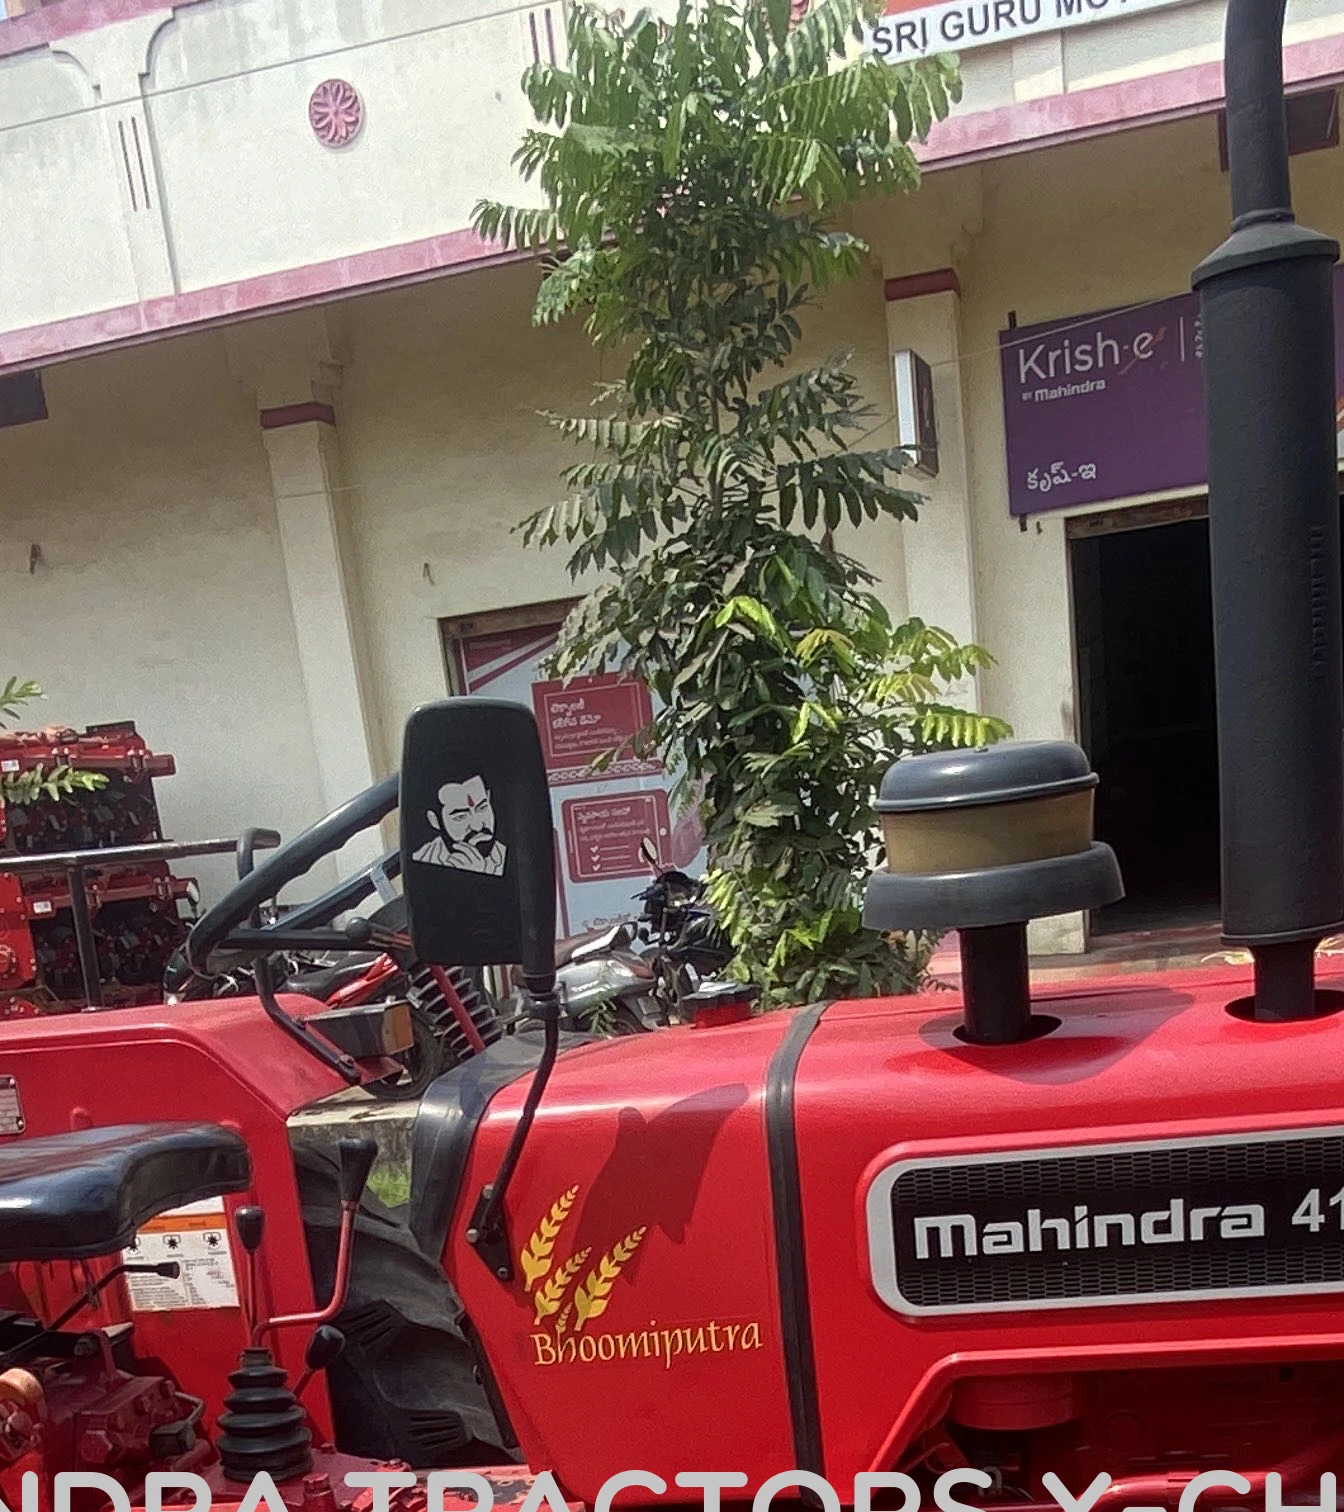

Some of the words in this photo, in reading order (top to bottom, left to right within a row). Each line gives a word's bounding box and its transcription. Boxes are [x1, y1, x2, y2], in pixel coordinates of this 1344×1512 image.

[871, 18, 929, 57] SRI
[940, 0, 1043, 42] GURU
[1034, 379, 1107, 402] Mahindra
[914, 1199, 1265, 1260] Mahindra
[529, 1319, 764, 1370] Bhoomiputra
